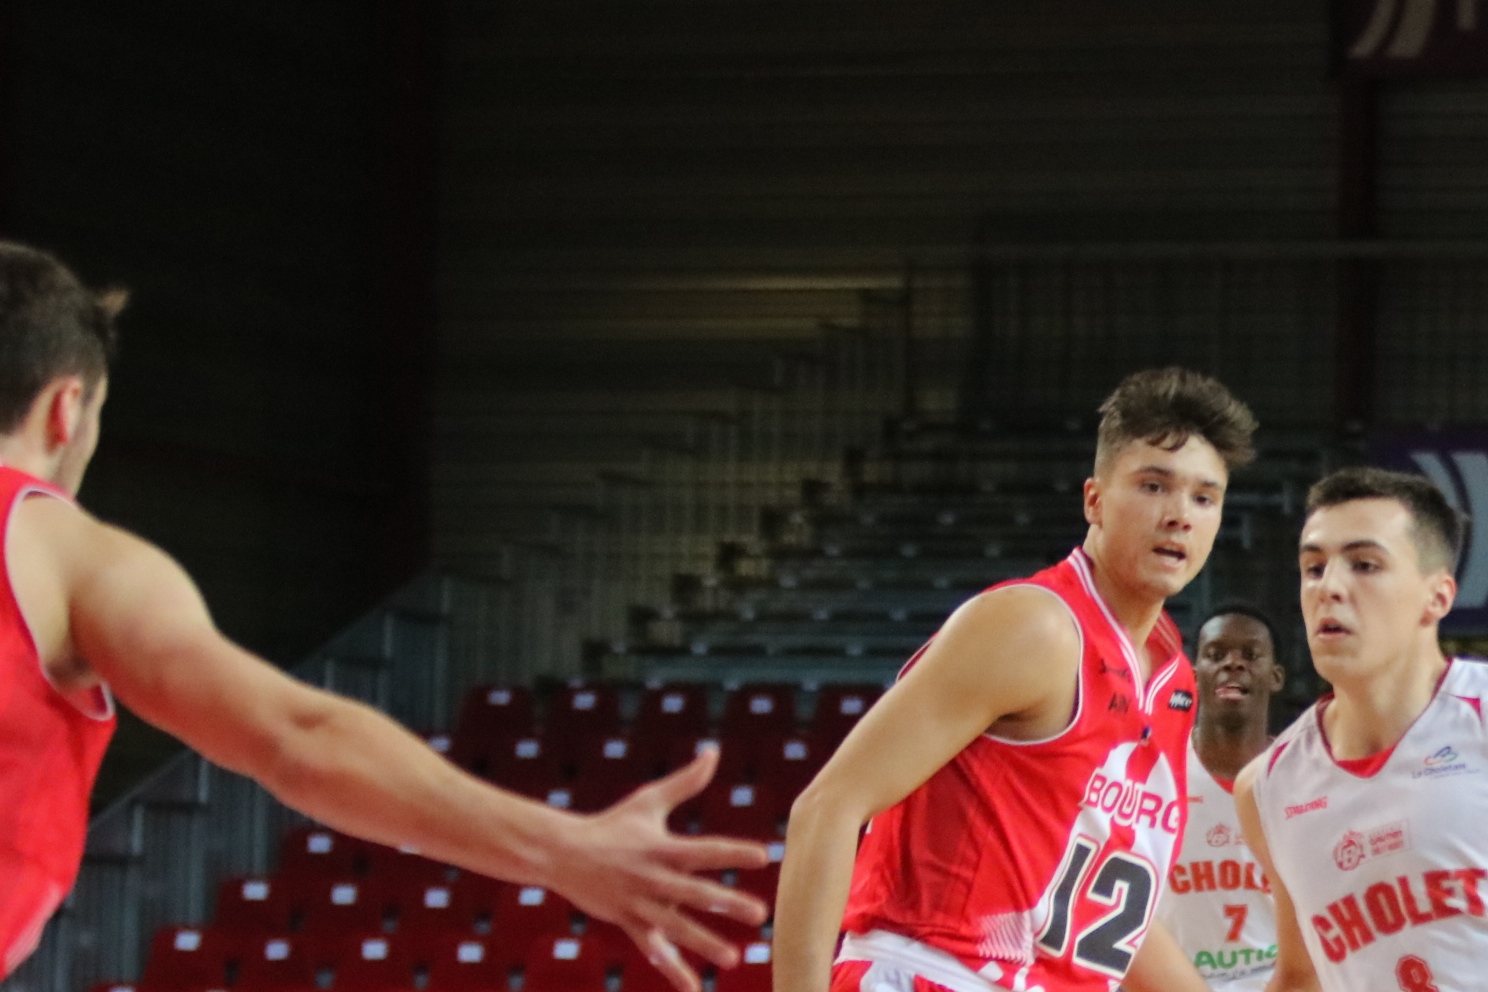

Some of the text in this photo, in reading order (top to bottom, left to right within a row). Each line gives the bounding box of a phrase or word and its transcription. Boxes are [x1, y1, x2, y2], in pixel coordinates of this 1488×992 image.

[1085, 771, 1182, 835] BOURG
[1035, 834, 1158, 980] 12
[1223, 903, 1249, 943] 7
[1311, 867, 1488, 964] CHOLET
